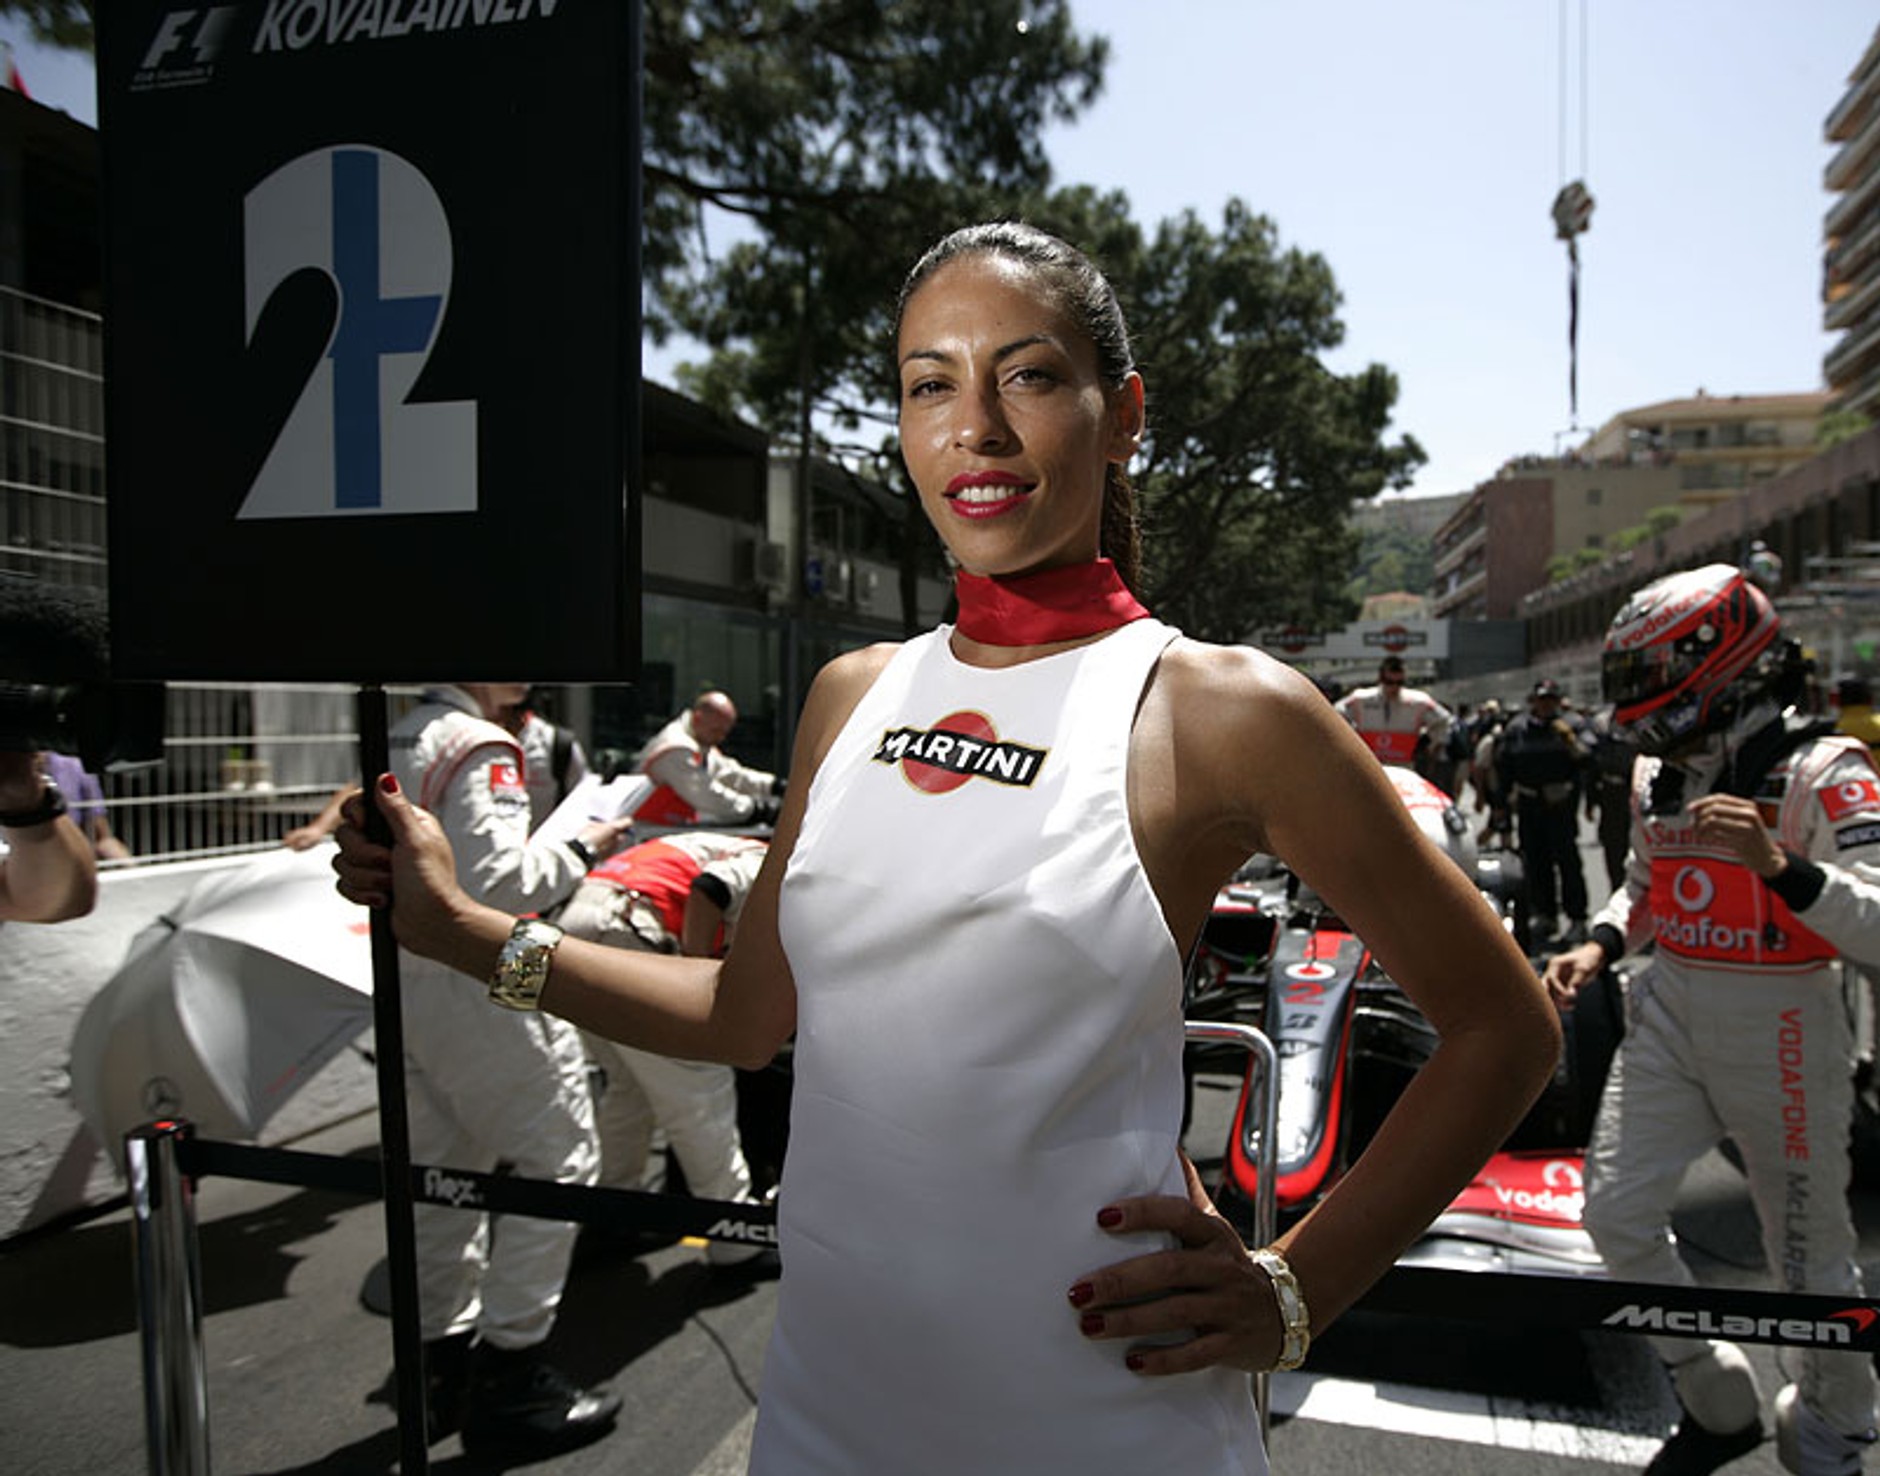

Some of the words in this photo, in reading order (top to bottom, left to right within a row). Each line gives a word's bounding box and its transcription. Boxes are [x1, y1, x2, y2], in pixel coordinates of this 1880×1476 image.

[236, 145, 477, 519] 2
[879, 733, 1034, 781] MARTINI
[1283, 982, 1325, 1005] 2
[1777, 1008, 1808, 1161] VODAFONE
[1602, 1305, 1851, 1343] McLaren
